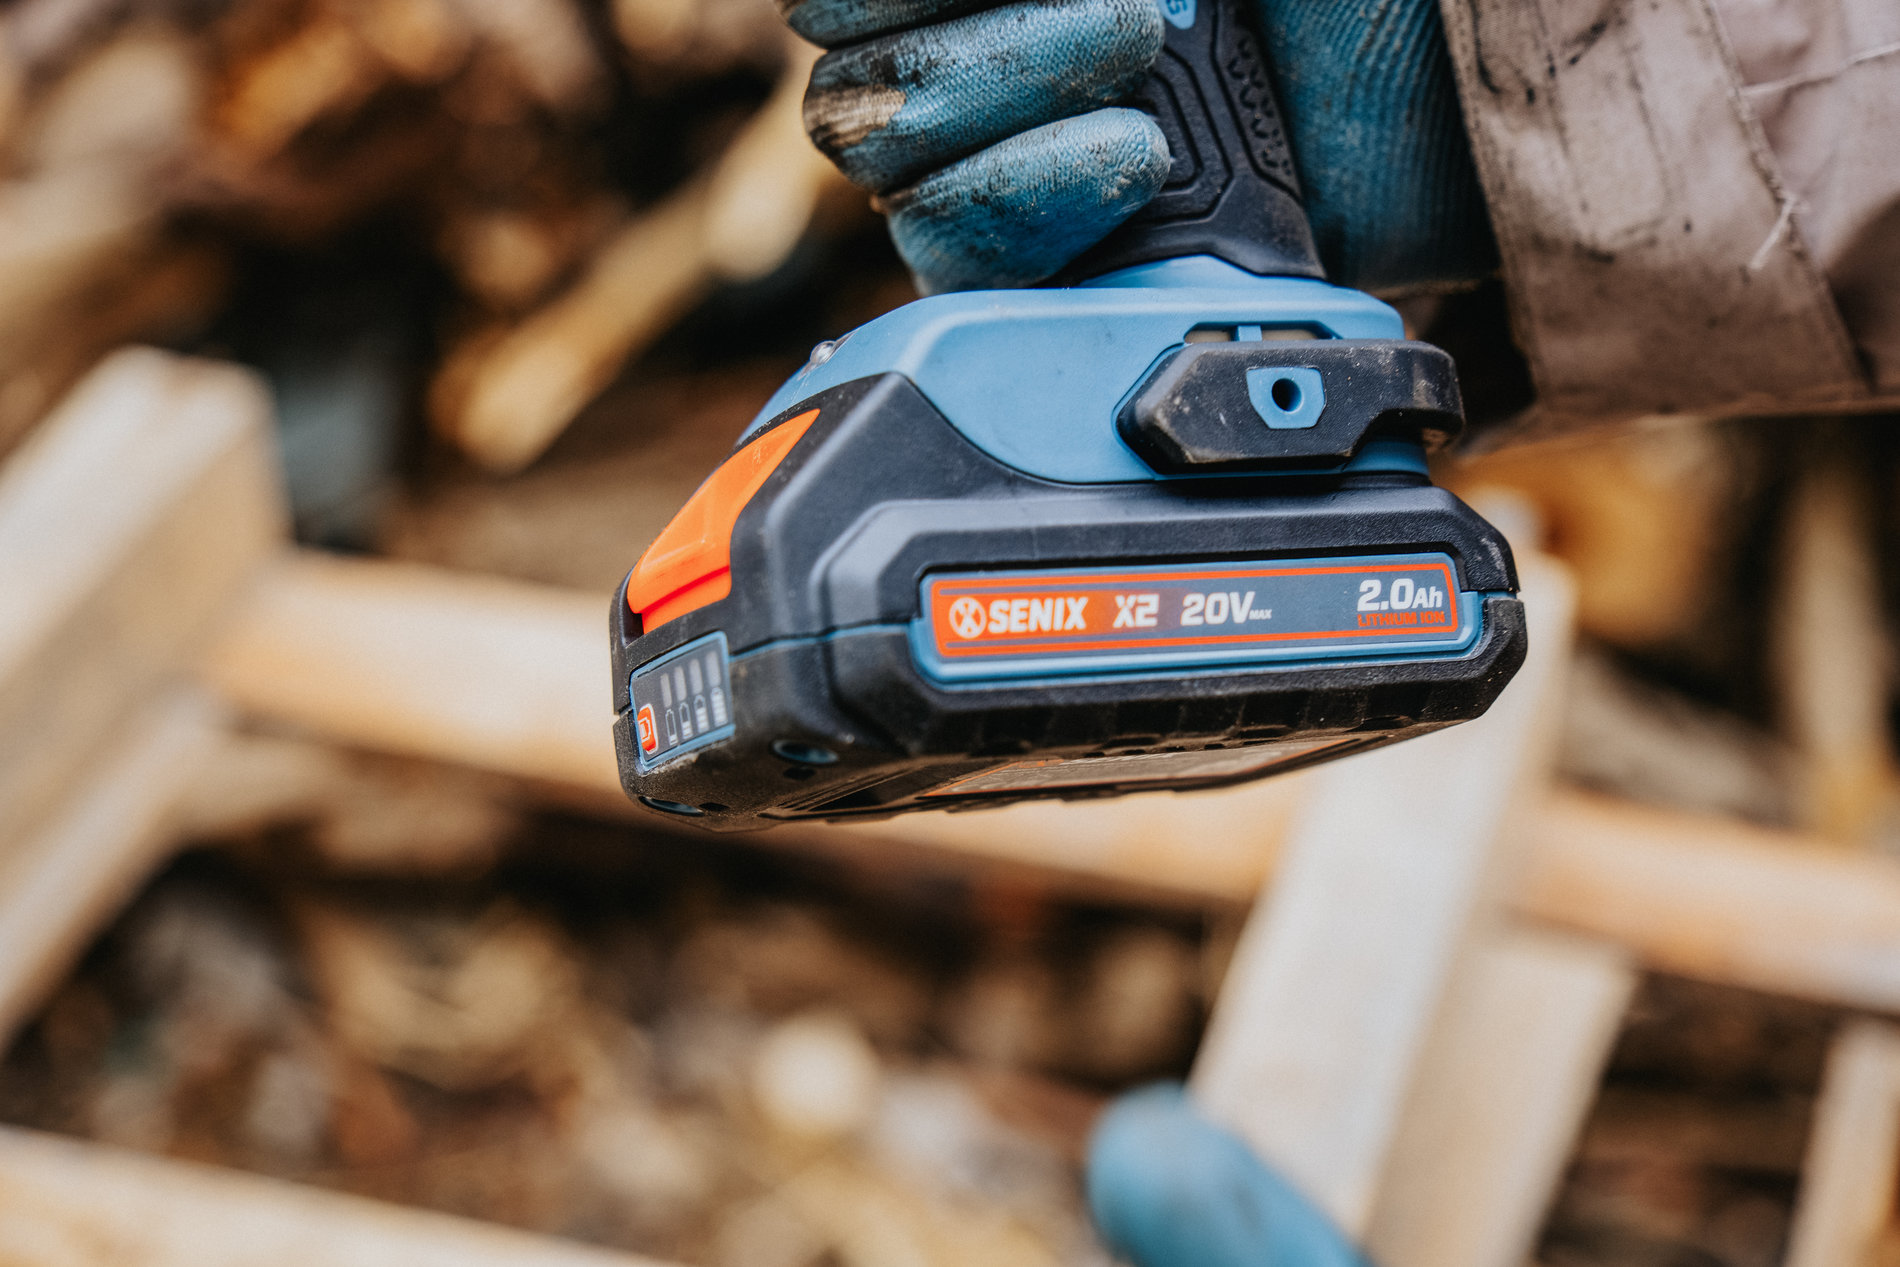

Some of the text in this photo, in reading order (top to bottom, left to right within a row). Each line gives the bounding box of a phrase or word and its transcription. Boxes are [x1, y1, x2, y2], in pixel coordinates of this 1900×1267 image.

[1357, 578, 1443, 612] 2.0Ah
[987, 597, 1088, 634] SENIX
[1112, 594, 1160, 628] X2
[1357, 611, 1446, 627] LITHIUM ION
